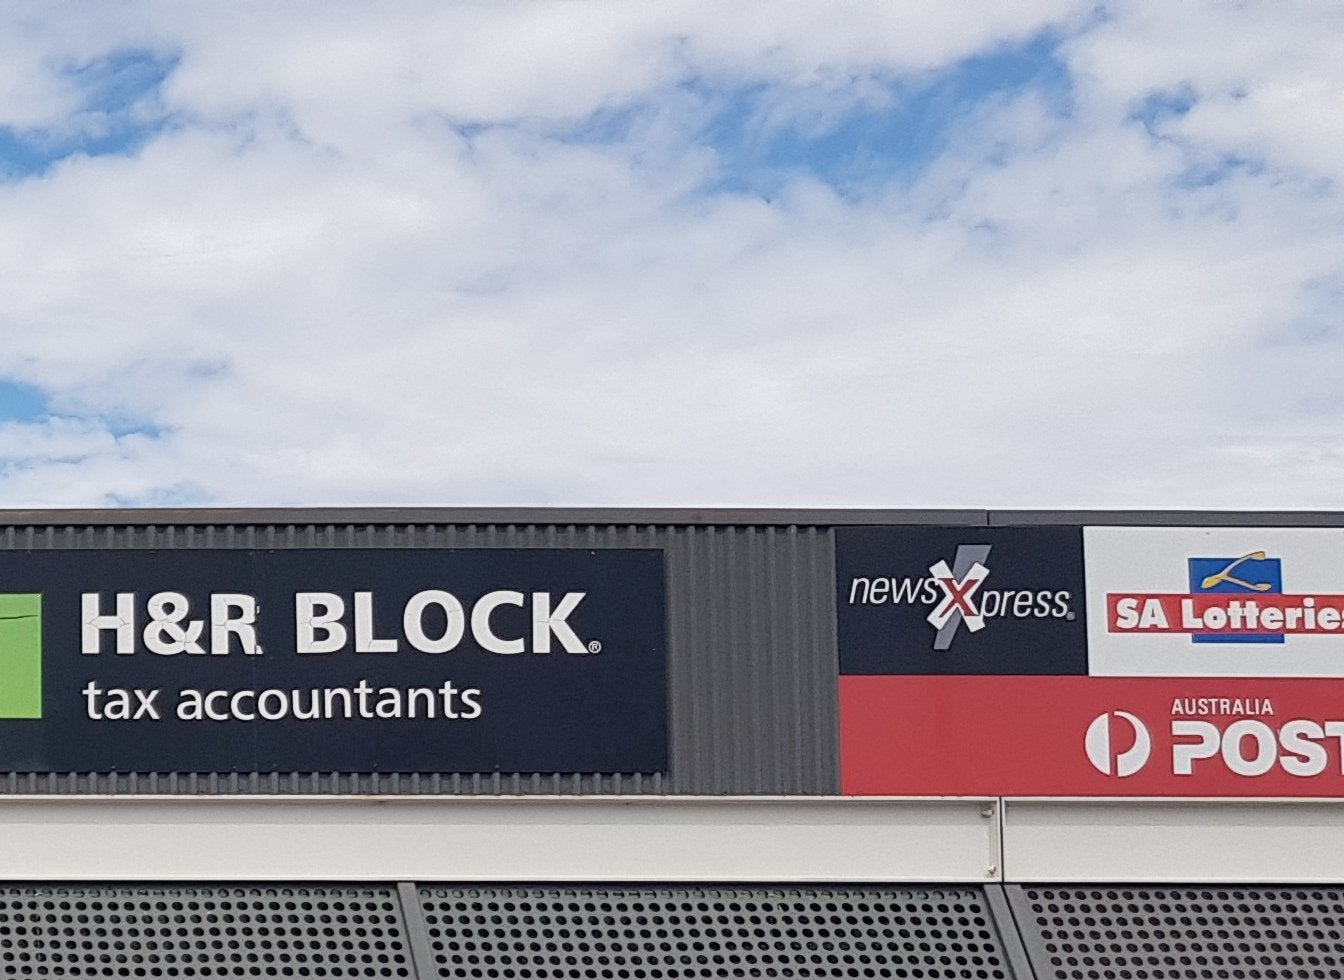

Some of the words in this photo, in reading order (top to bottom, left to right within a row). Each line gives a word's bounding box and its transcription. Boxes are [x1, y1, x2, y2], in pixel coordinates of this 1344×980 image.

[81, 592, 263, 655] H&R
[296, 590, 589, 655] BLOCK
[1116, 598, 1169, 629] SA
[1182, 598, 1344, 629] Lotterie
[83, 681, 159, 720] tax
[177, 679, 482, 720] accountants
[1172, 699, 1273, 715] AUSTRALIA
